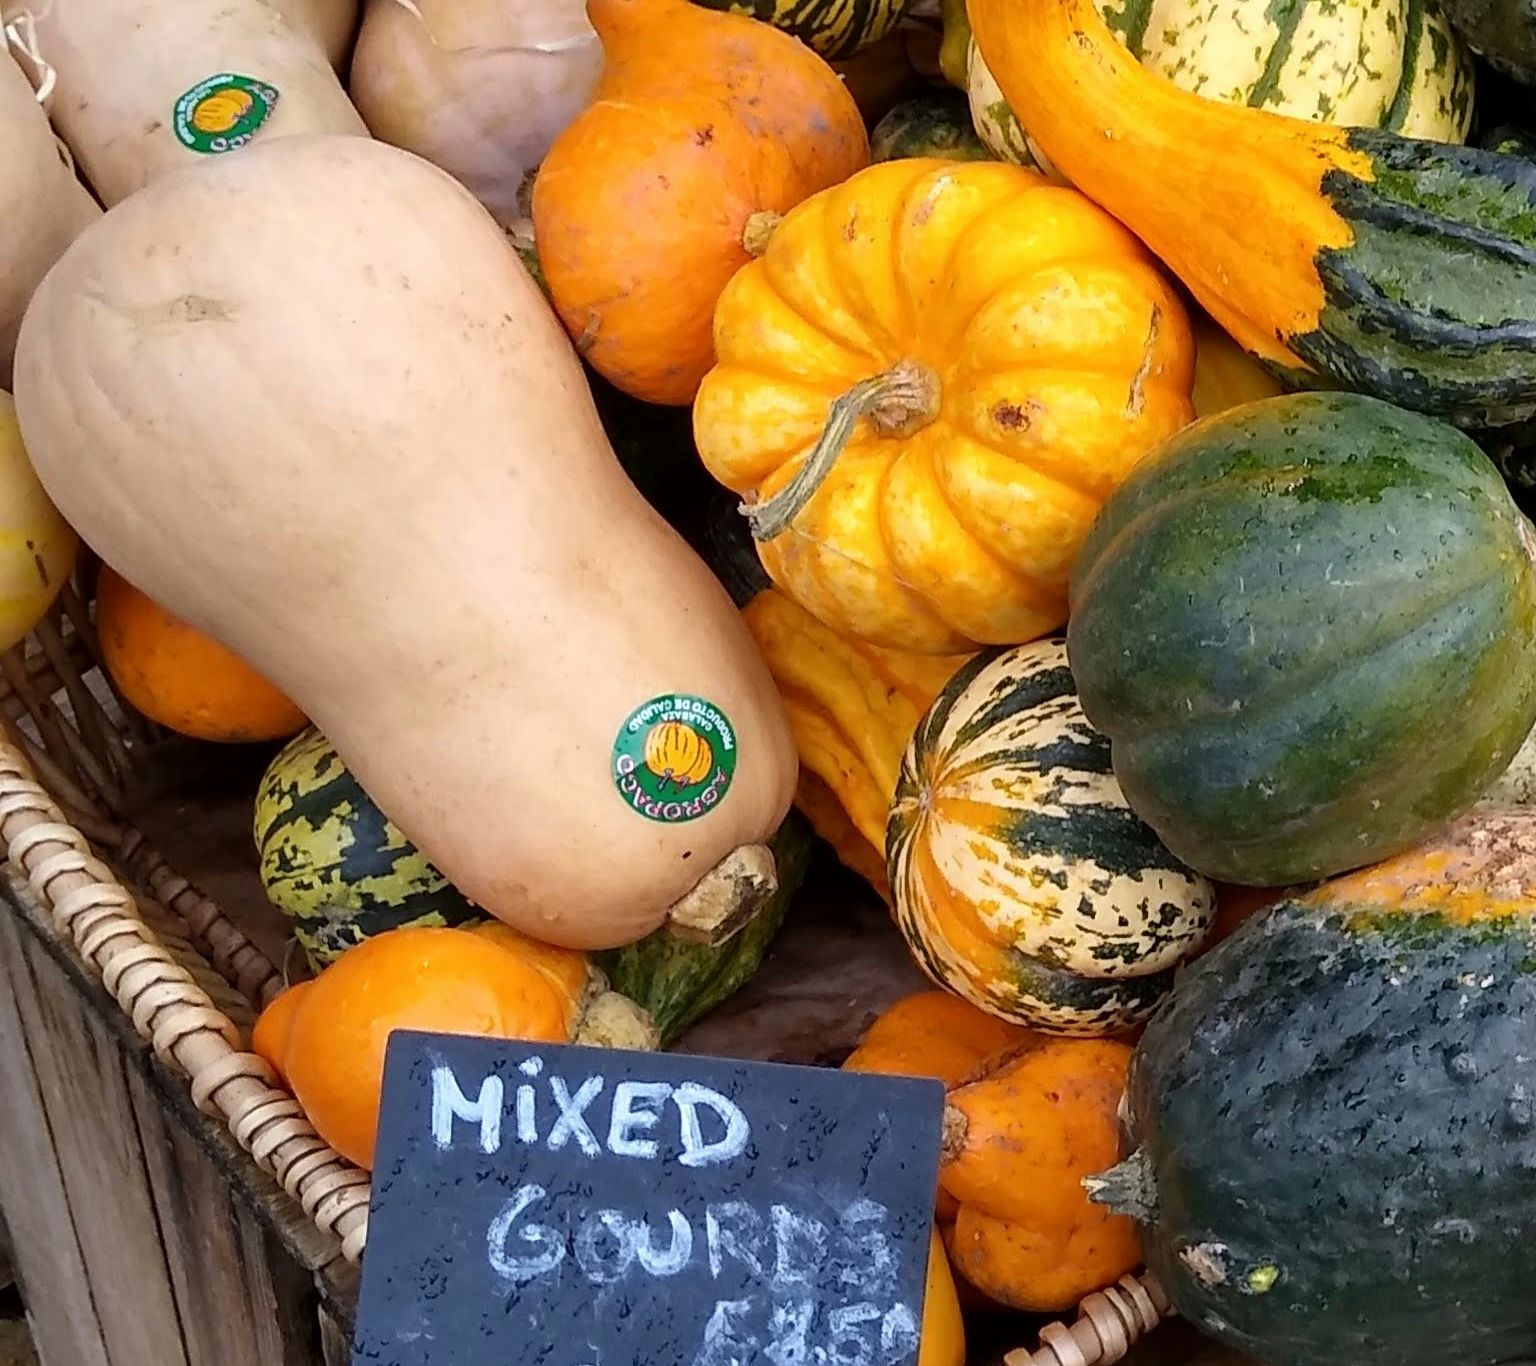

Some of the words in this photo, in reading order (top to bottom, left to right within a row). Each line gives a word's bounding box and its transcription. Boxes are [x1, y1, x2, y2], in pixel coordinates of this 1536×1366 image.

[629, 699, 673, 731] CALIDAD
[660, 710, 713, 732] CALABAZA
[674, 698, 691, 710] DE
[692, 699, 734, 751] PRODUCTO
[617, 754, 728, 819] AGROPACO
[486, 1184, 899, 1297] GOURDS
